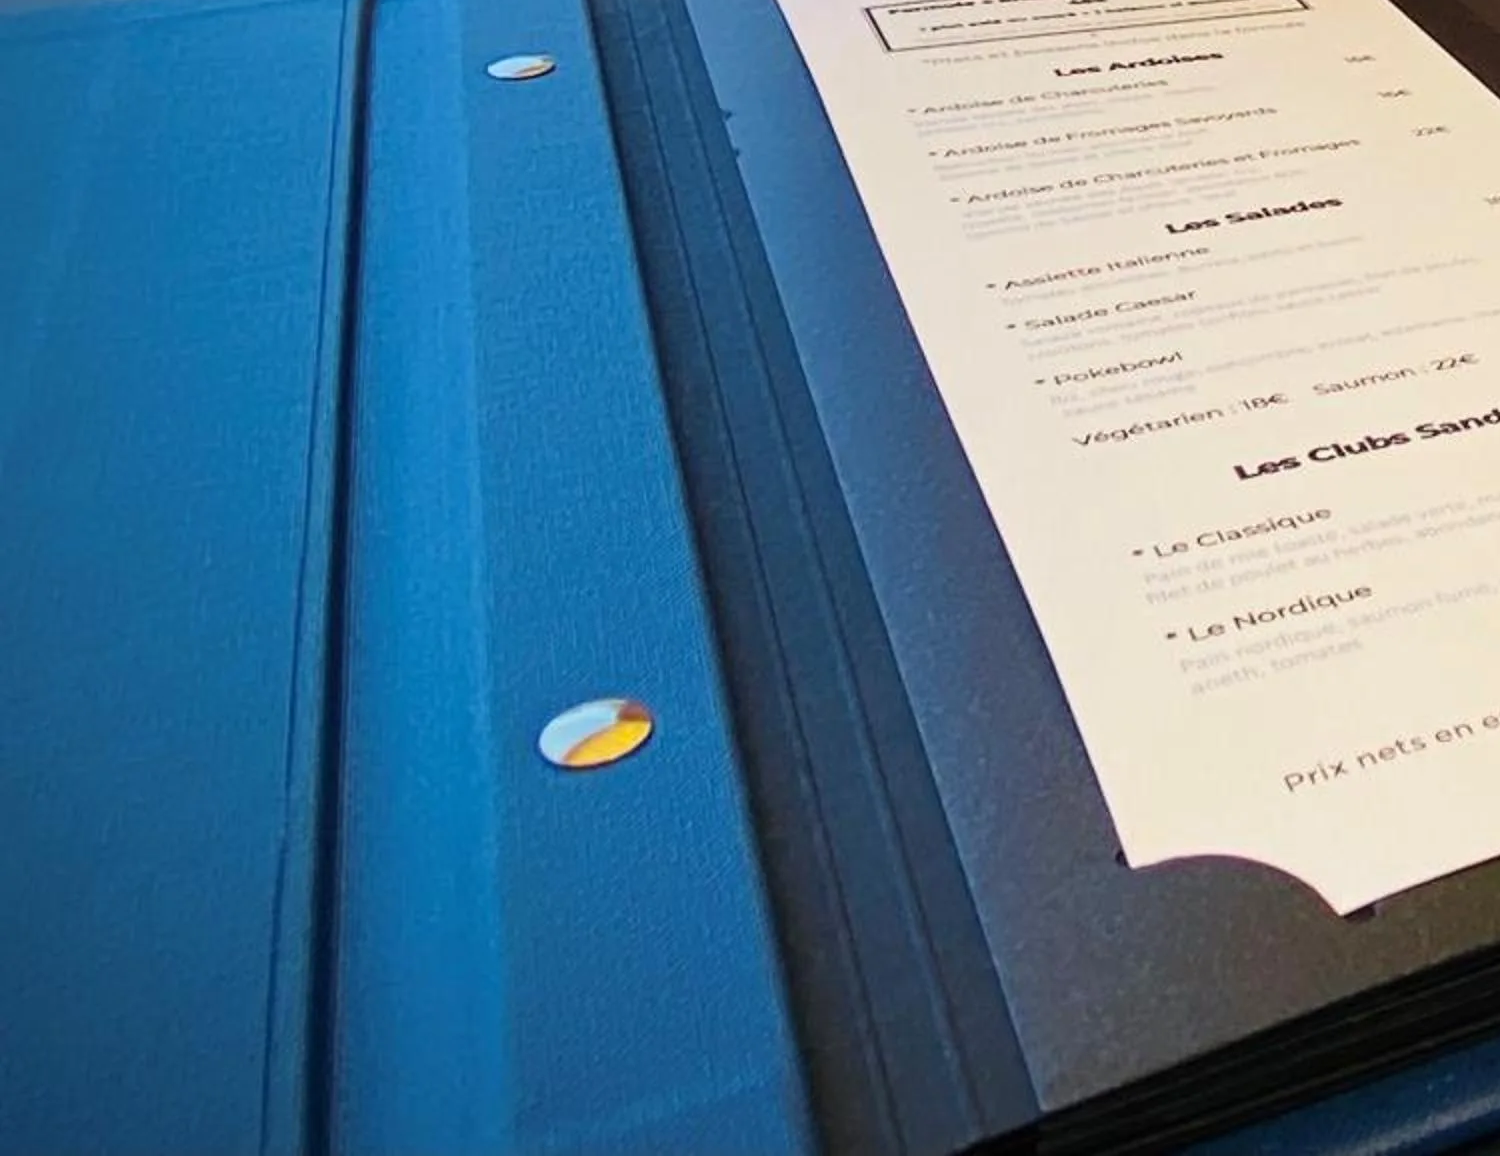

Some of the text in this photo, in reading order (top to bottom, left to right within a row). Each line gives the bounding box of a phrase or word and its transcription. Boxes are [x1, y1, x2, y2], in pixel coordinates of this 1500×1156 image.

[1054, 51, 1225, 79] Les Ardoises
[923, 78, 1170, 116] Ardoise de Charcuteries
[943, 141, 1029, 159] Ardoise
[1032, 134, 1062, 147] de
[1064, 119, 1173, 142] Fromages
[967, 184, 1056, 205] Ardoise
[1059, 177, 1089, 190] de
[1092, 156, 1232, 186] Charcuteries
[1258, 137, 1362, 163] Fromages
[1164, 197, 1345, 236] Les Salades
[1003, 262, 1103, 292] Assiette
[1105, 244, 1212, 274] Italienne
[1023, 287, 1200, 332] Salade Caesar
[1053, 349, 1184, 386] Pokebowl
[1312, 363, 1418, 398] Saumon
[1072, 403, 1225, 448] Végétarien
[1234, 453, 1302, 482] Les
[1306, 426, 1413, 463] Clubs
[1152, 506, 1334, 559] Le Classique
[1187, 584, 1374, 643] Le Nordique
[1283, 756, 1349, 794] Prix
[1356, 732, 1429, 770] nets
[1434, 718, 1475, 745] en
